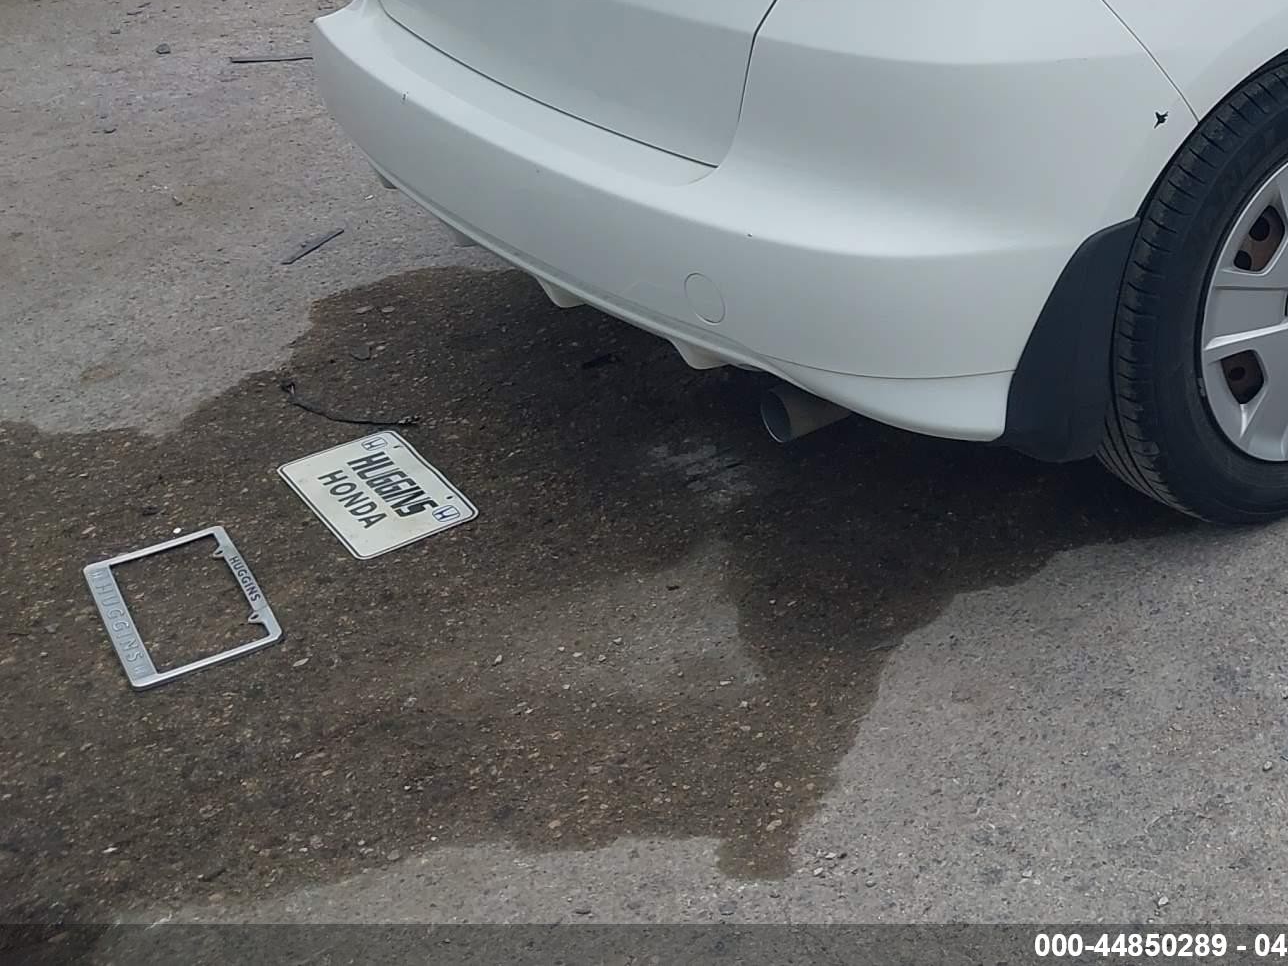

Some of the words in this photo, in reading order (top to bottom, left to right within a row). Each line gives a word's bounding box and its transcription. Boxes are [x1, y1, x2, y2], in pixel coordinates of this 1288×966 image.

[318, 469, 388, 530] HONDA
[347, 451, 439, 518] HUGGINS
[228, 555, 261, 603] HUGGINS
[95, 577, 145, 664] HUGGINS
